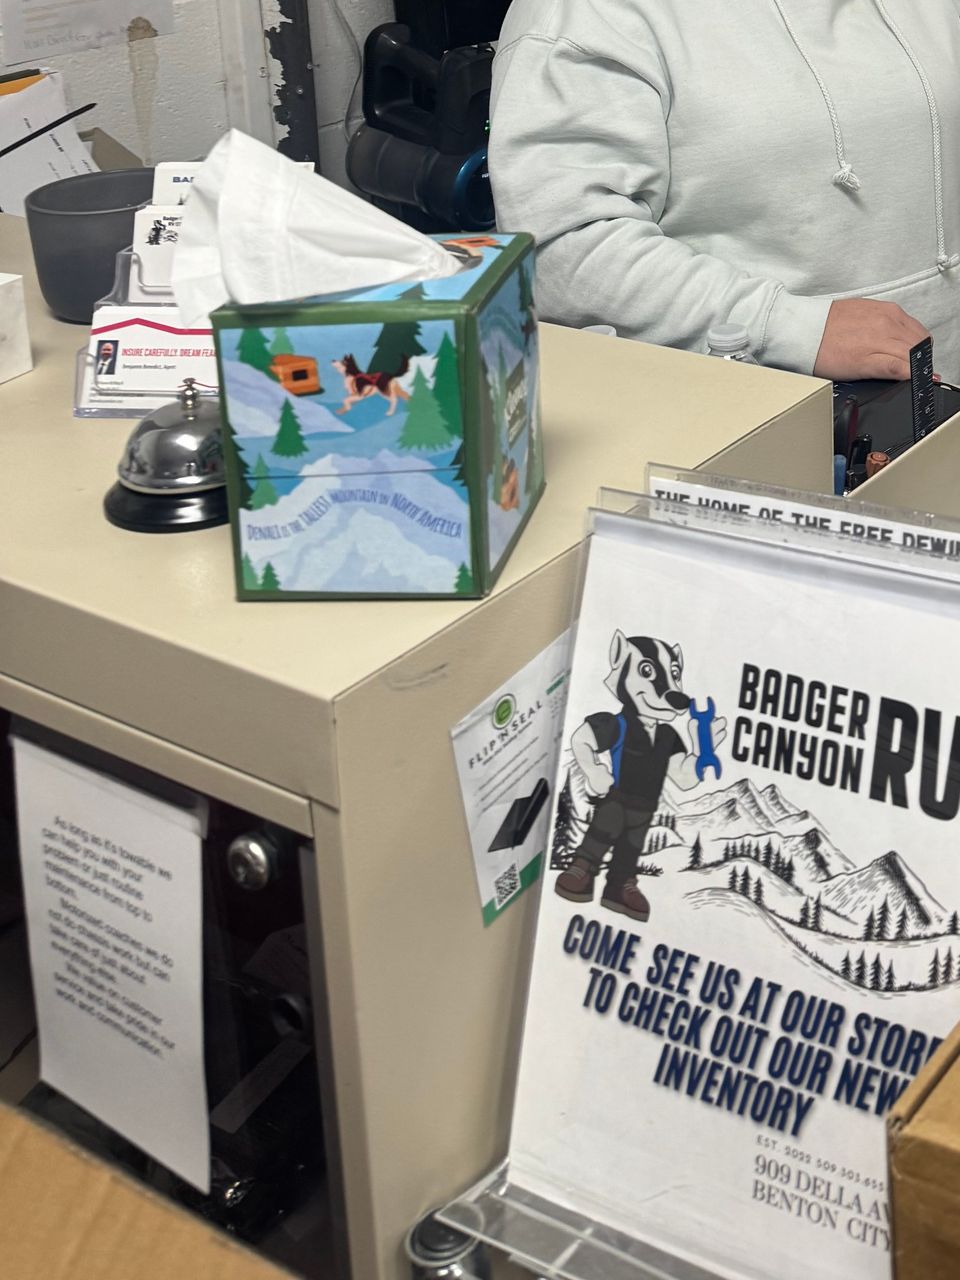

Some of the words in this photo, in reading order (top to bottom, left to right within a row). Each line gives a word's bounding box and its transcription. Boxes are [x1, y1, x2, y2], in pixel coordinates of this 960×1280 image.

[121, 348, 143, 357] INSURE
[179, 348, 201, 357] DREAM
[298, 495, 332, 526] TALLEST
[328, 488, 378, 504] MOUNTAIN
[390, 492, 421, 521] NORTH
[416, 510, 462, 538] AMERICA
[655, 489, 691, 505] THE
[698, 497, 750, 516] HOME
[791, 513, 832, 532] THE
[839, 520, 893, 544] FREE
[468, 739, 496, 770] FLIP
[511, 700, 543, 732] SEAL
[738, 662, 871, 741] BADGER
[731, 716, 864, 794] CANYON
[562, 914, 642, 977] COME
[646, 943, 701, 998] SEE
[699, 960, 741, 1011] US
[740, 976, 783, 1025] AT
[780, 989, 848, 1050] OUR
[582, 967, 619, 1015] TO
[618, 982, 712, 1052] CHECK
[709, 1015, 770, 1076] OUT
[768, 1036, 834, 1097] OUR
[832, 1057, 911, 1118] NEW
[652, 1042, 816, 1138] INVENTORY
[754, 1154, 791, 1185] 909
[795, 1168, 863, 1214] DELLA
[756, 1134, 781, 1152] EST.
[784, 1145, 812, 1164] 2022
[752, 1179, 839, 1230] BENTON
[846, 1217, 892, 1253] CITY
